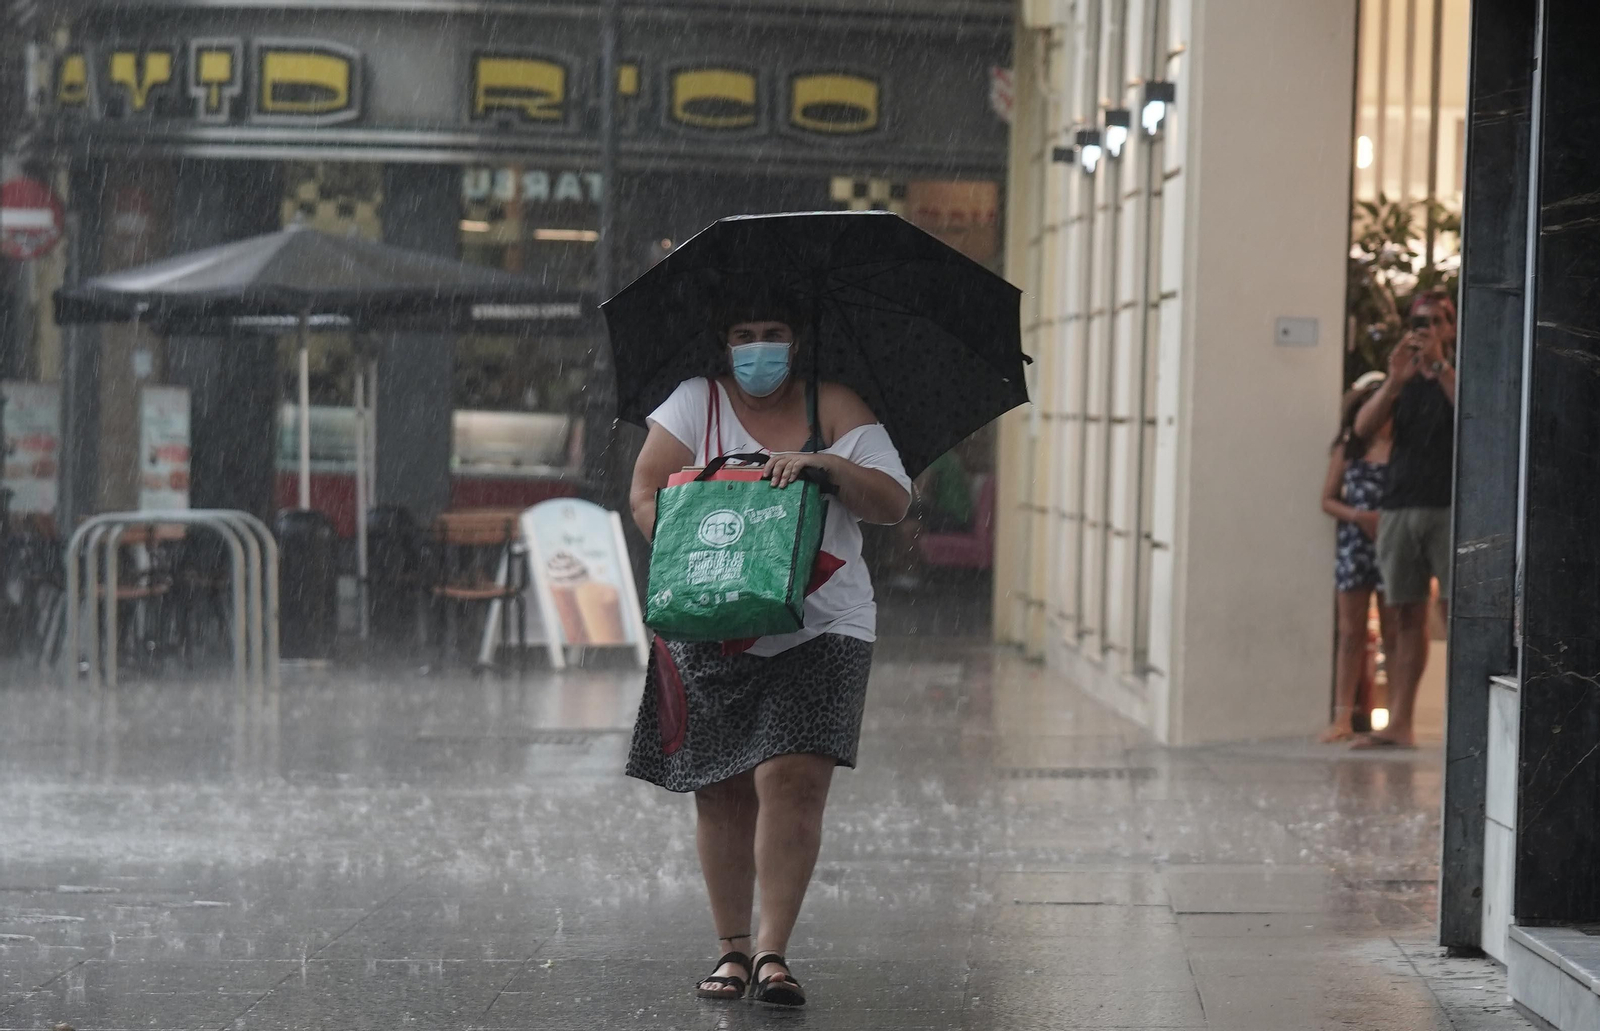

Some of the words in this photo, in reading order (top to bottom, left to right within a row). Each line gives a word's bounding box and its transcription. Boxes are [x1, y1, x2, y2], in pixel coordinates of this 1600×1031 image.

[48, 46, 354, 118] AVID
[689, 550, 730, 561] MUESTRA
[733, 550, 745, 560] DE
[687, 559, 744, 572] PRODUCTOS
